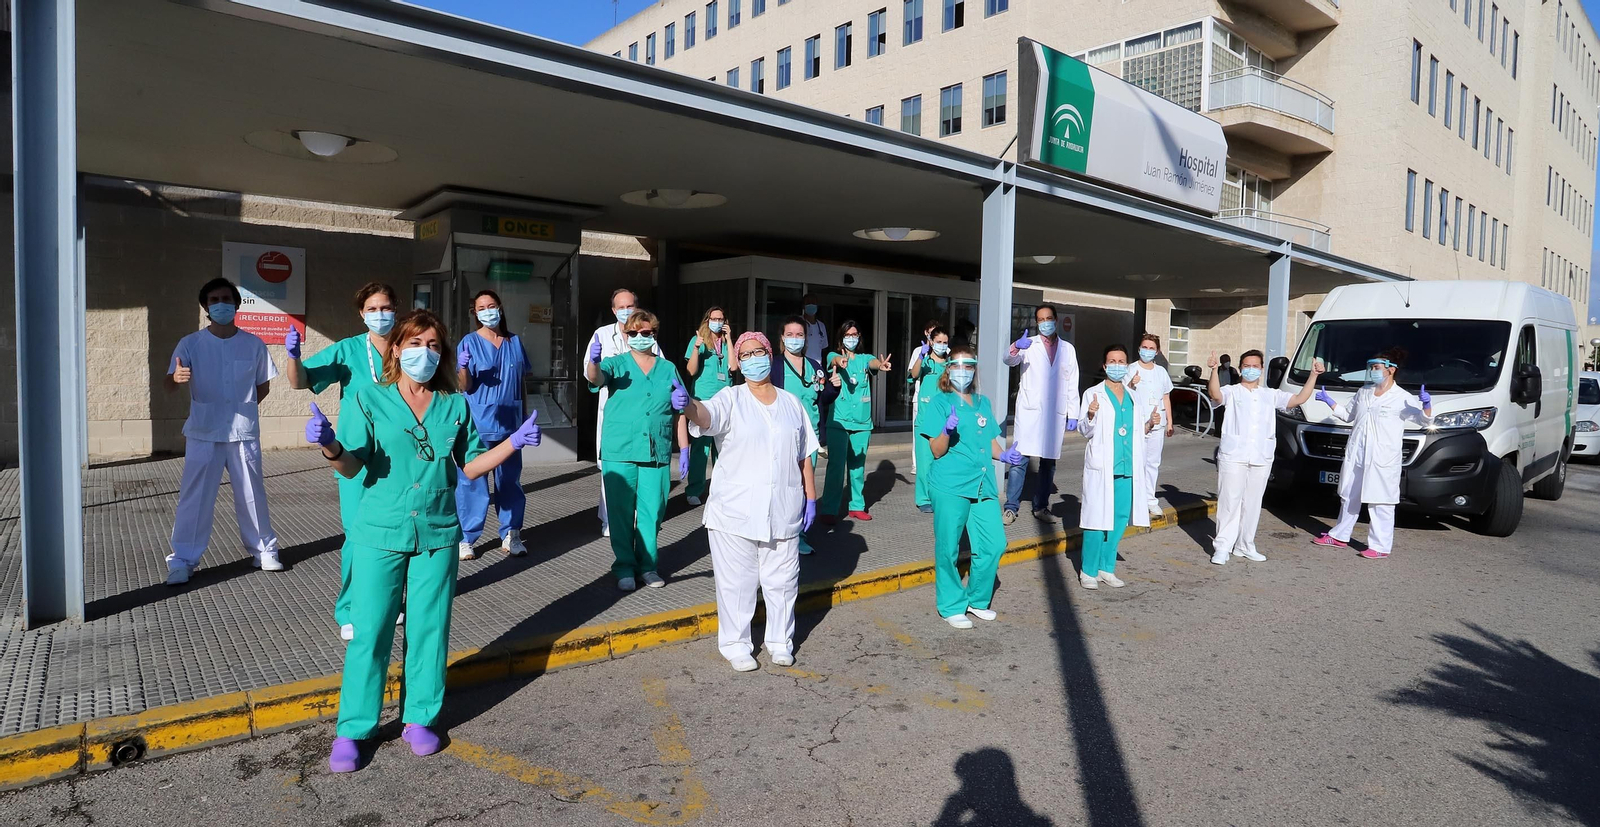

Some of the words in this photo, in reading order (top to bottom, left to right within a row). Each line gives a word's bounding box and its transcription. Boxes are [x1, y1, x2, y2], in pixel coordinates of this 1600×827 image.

[1048, 135, 1060, 146] JUNTA
[1060, 139, 1066, 148] DE
[1179, 147, 1219, 178] Hospital
[1143, 161, 1161, 179] Juan
[1163, 167, 1188, 187] Ramón
[1188, 176, 1215, 196] Jiménez
[422, 221, 437, 238] ONCE
[504, 220, 549, 236] ONCE
[242, 297, 255, 305] sin
[239, 314, 288, 323] ¡RECUERDE!
[1328, 473, 1340, 484] 68
